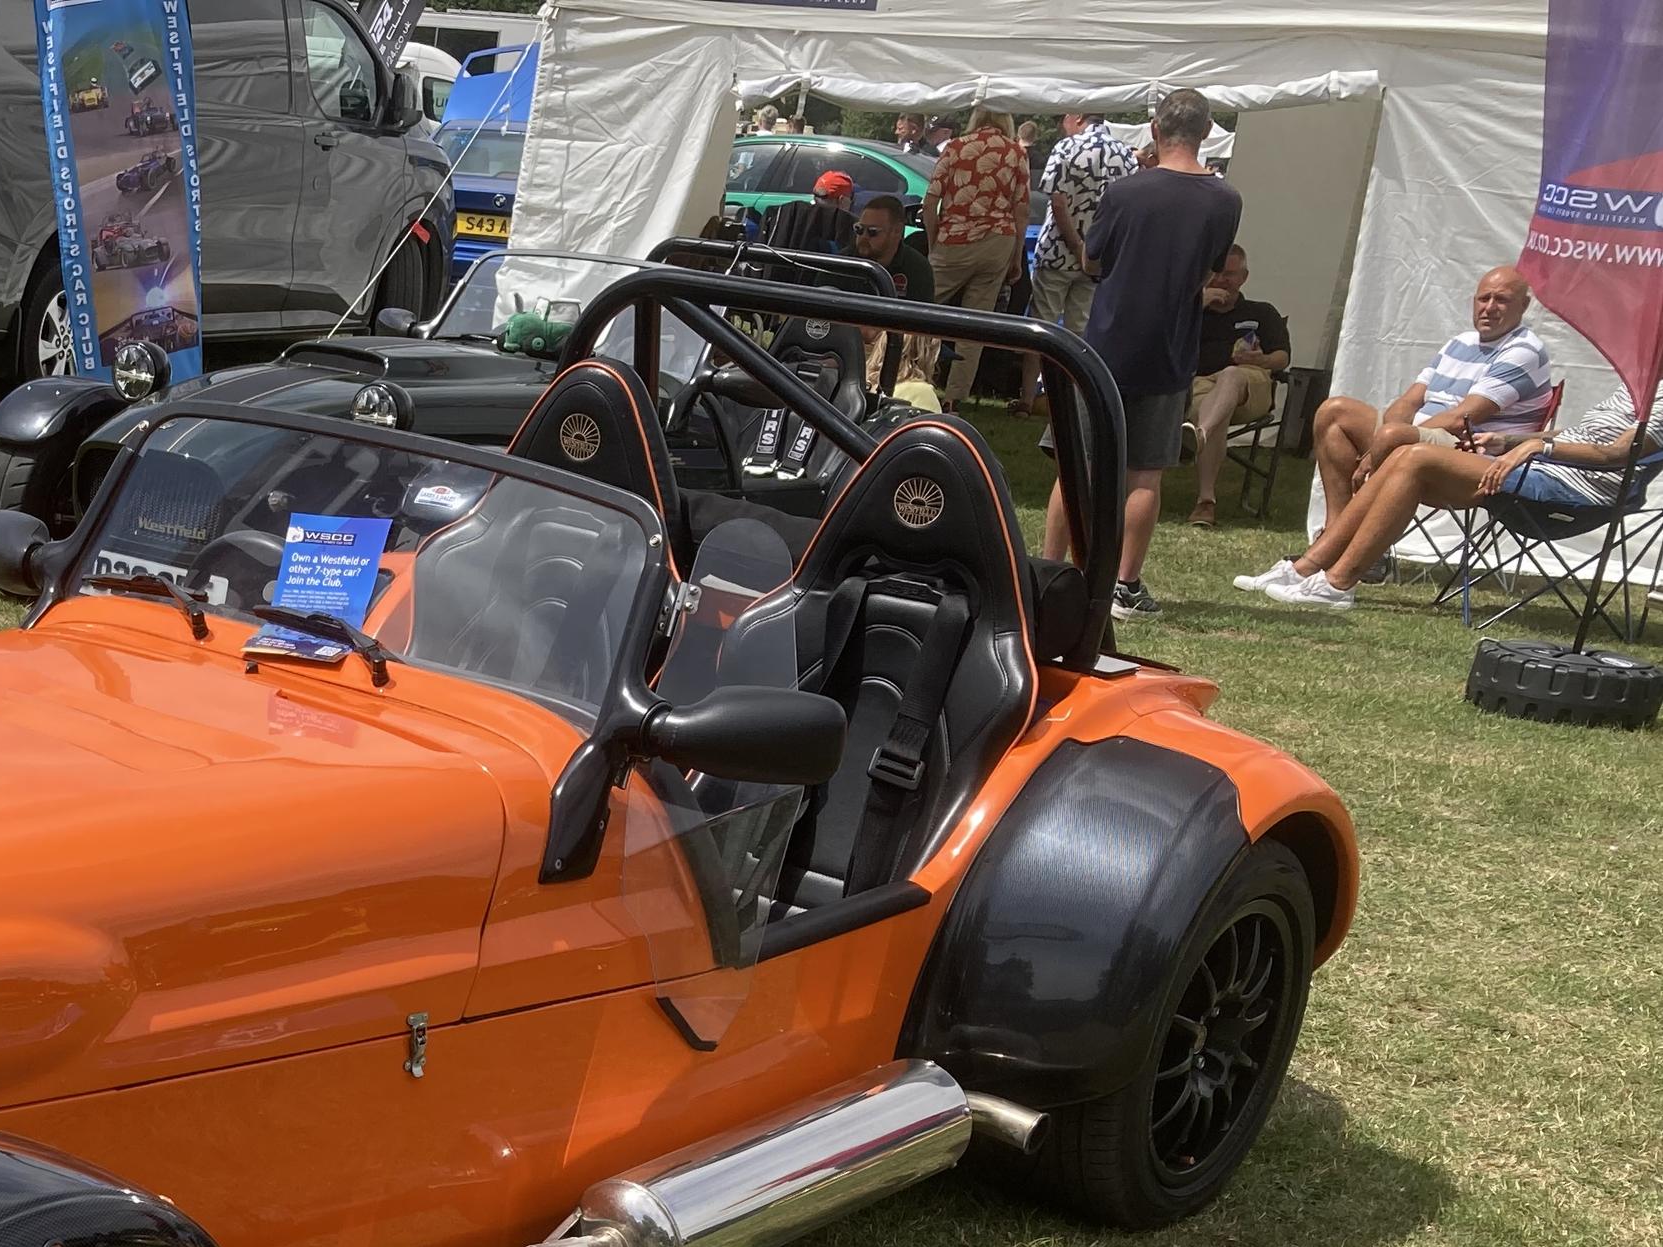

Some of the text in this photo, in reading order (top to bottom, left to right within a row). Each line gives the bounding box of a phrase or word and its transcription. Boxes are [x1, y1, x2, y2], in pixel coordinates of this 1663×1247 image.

[466, 216, 496, 233] S43
[138, 515, 207, 540] Westfield
[304, 531, 355, 542] WSCC
[291, 552, 371, 567] Own a Westfield or
[288, 565, 362, 577] other 7-type car?
[286, 577, 305, 585] Join
[306, 577, 321, 586] the
